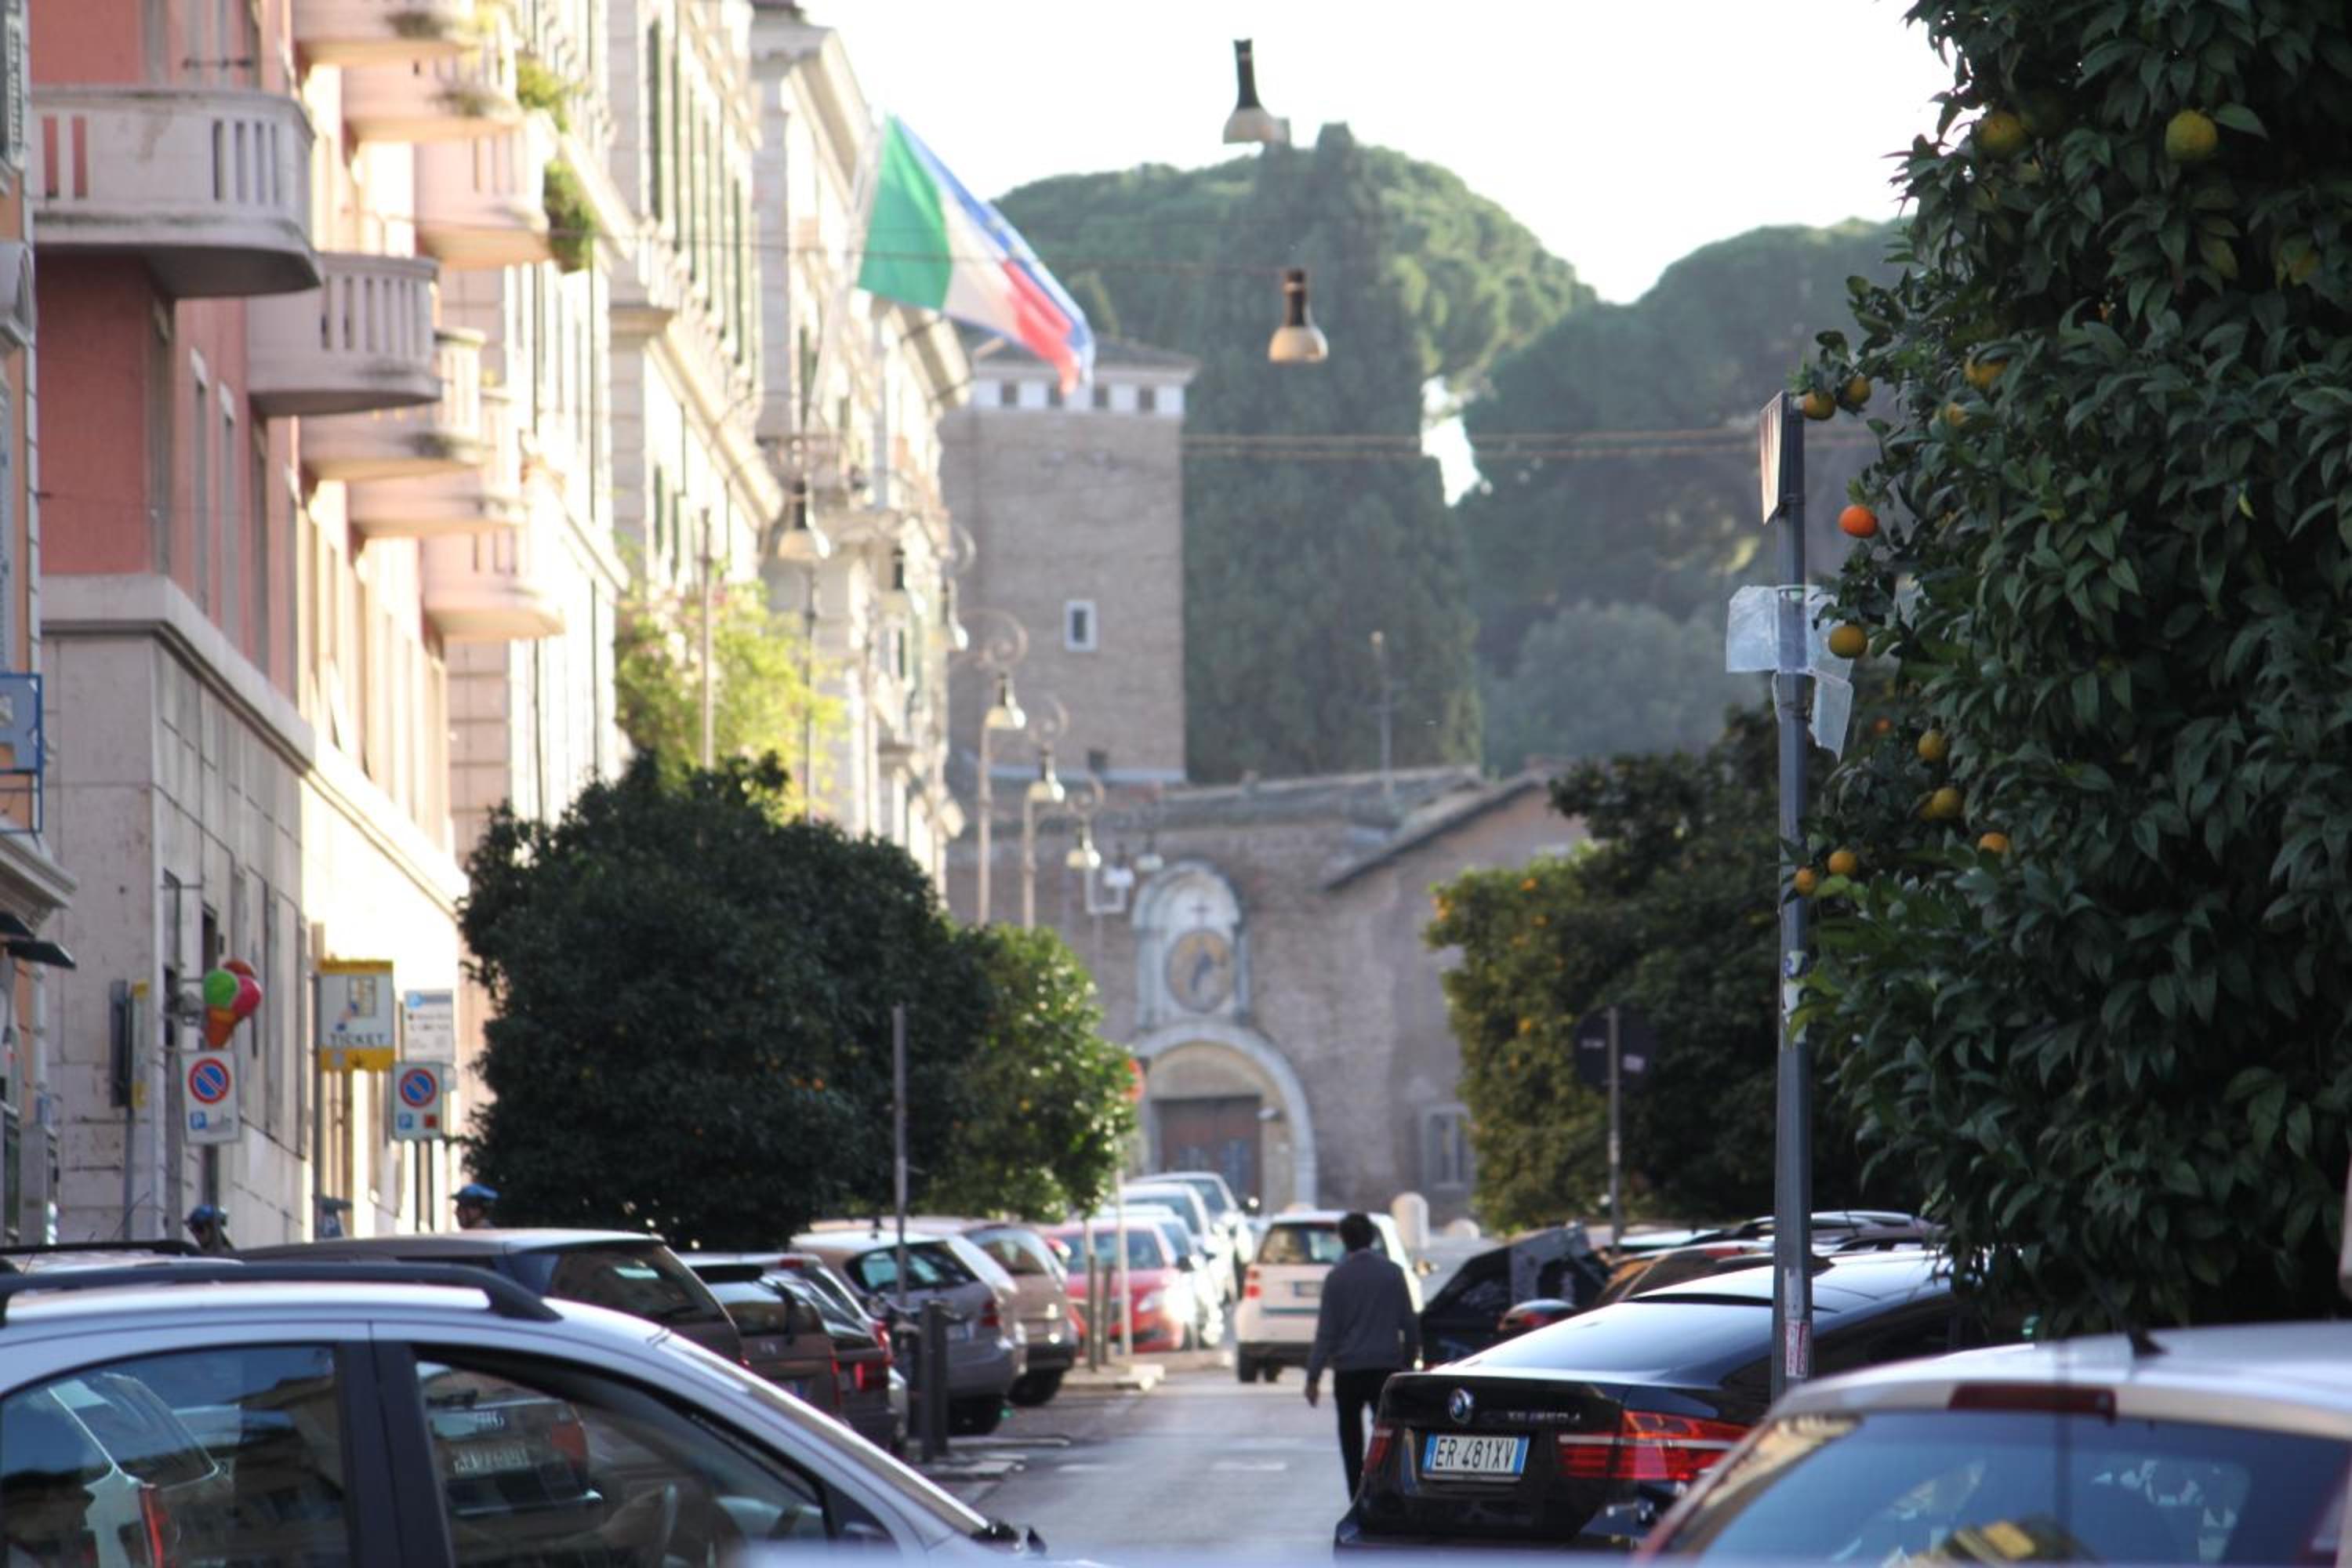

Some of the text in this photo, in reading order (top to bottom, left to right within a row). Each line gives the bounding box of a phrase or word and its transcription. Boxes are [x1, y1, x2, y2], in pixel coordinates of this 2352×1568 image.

[330, 1033, 384, 1047] TICKET
[1436, 1439, 1515, 1468] ER 481XV
